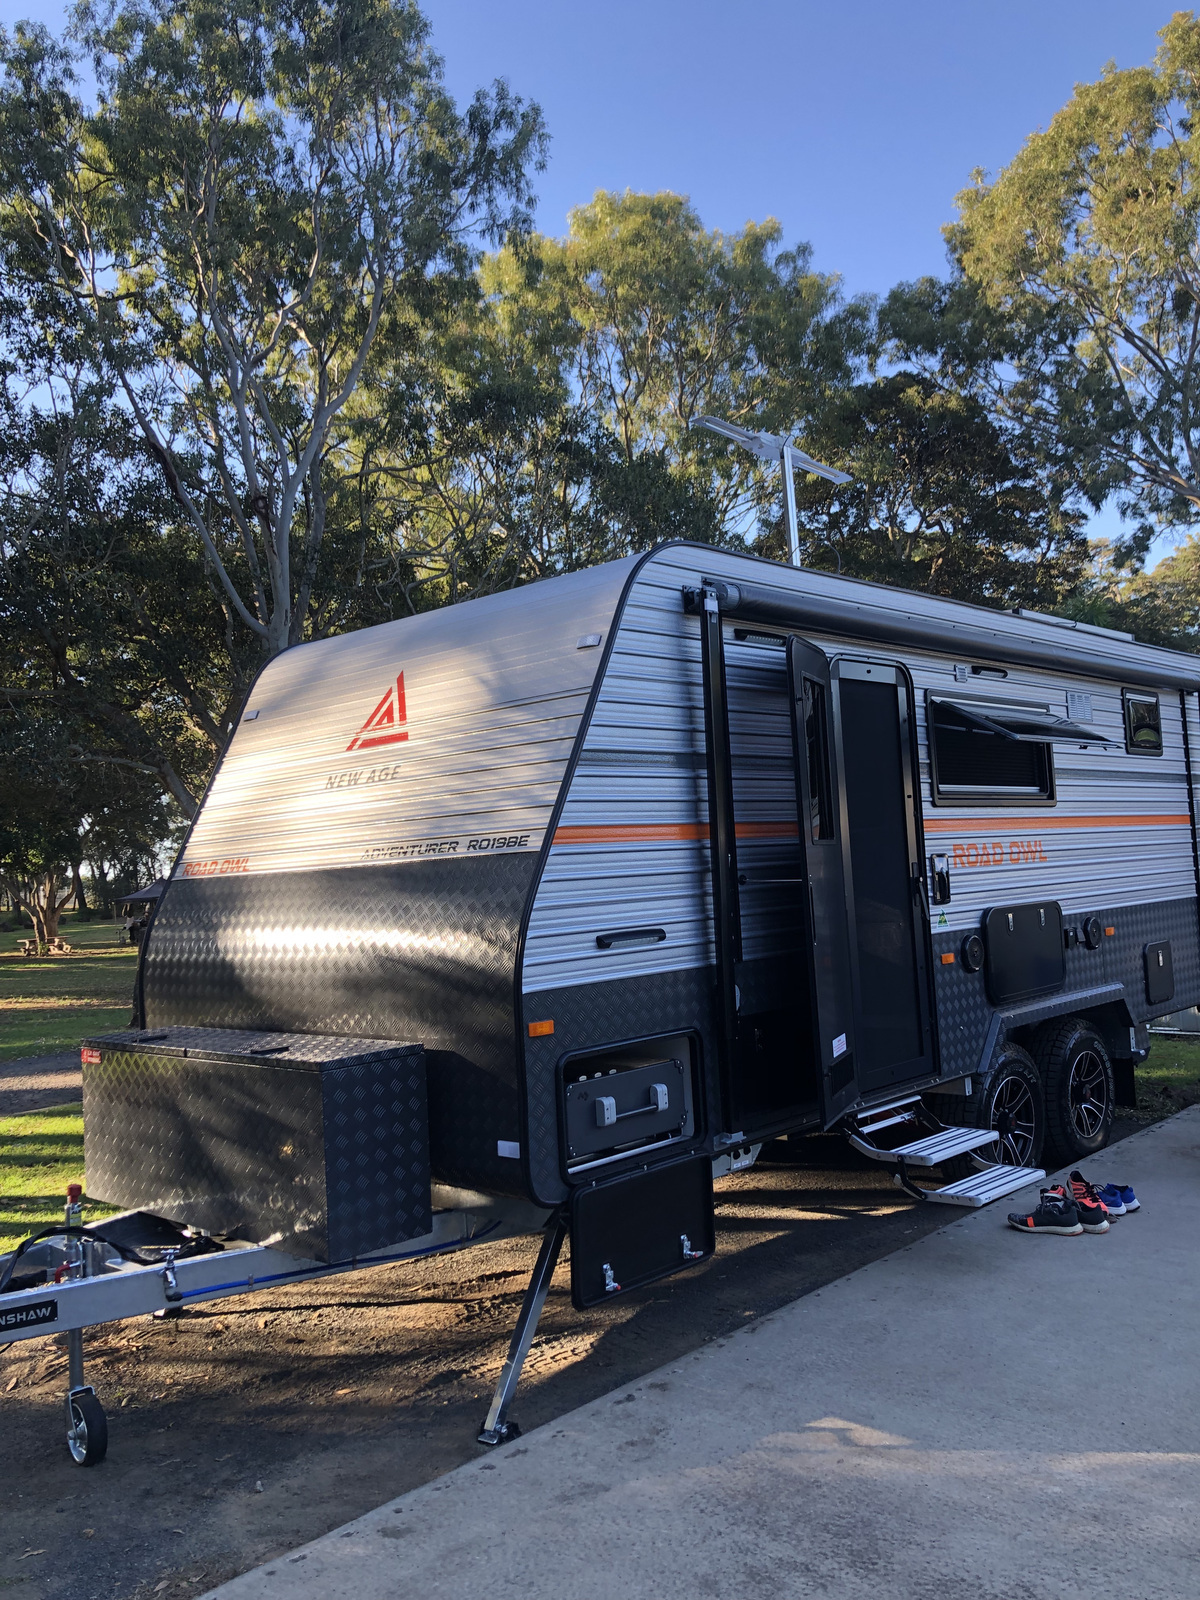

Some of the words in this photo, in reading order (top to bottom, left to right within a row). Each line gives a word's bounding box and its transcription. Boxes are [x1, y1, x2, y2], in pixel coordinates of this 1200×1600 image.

[325, 770, 364, 789] NEW
[365, 765, 402, 784] AGE
[360, 840, 459, 860] ADVENTURER
[466, 834, 531, 851] RO19BE
[952, 842, 1004, 868] ROAD
[1008, 840, 1048, 865] OWL
[181, 861, 219, 877] ROAD
[219, 857, 250, 874] OWL
